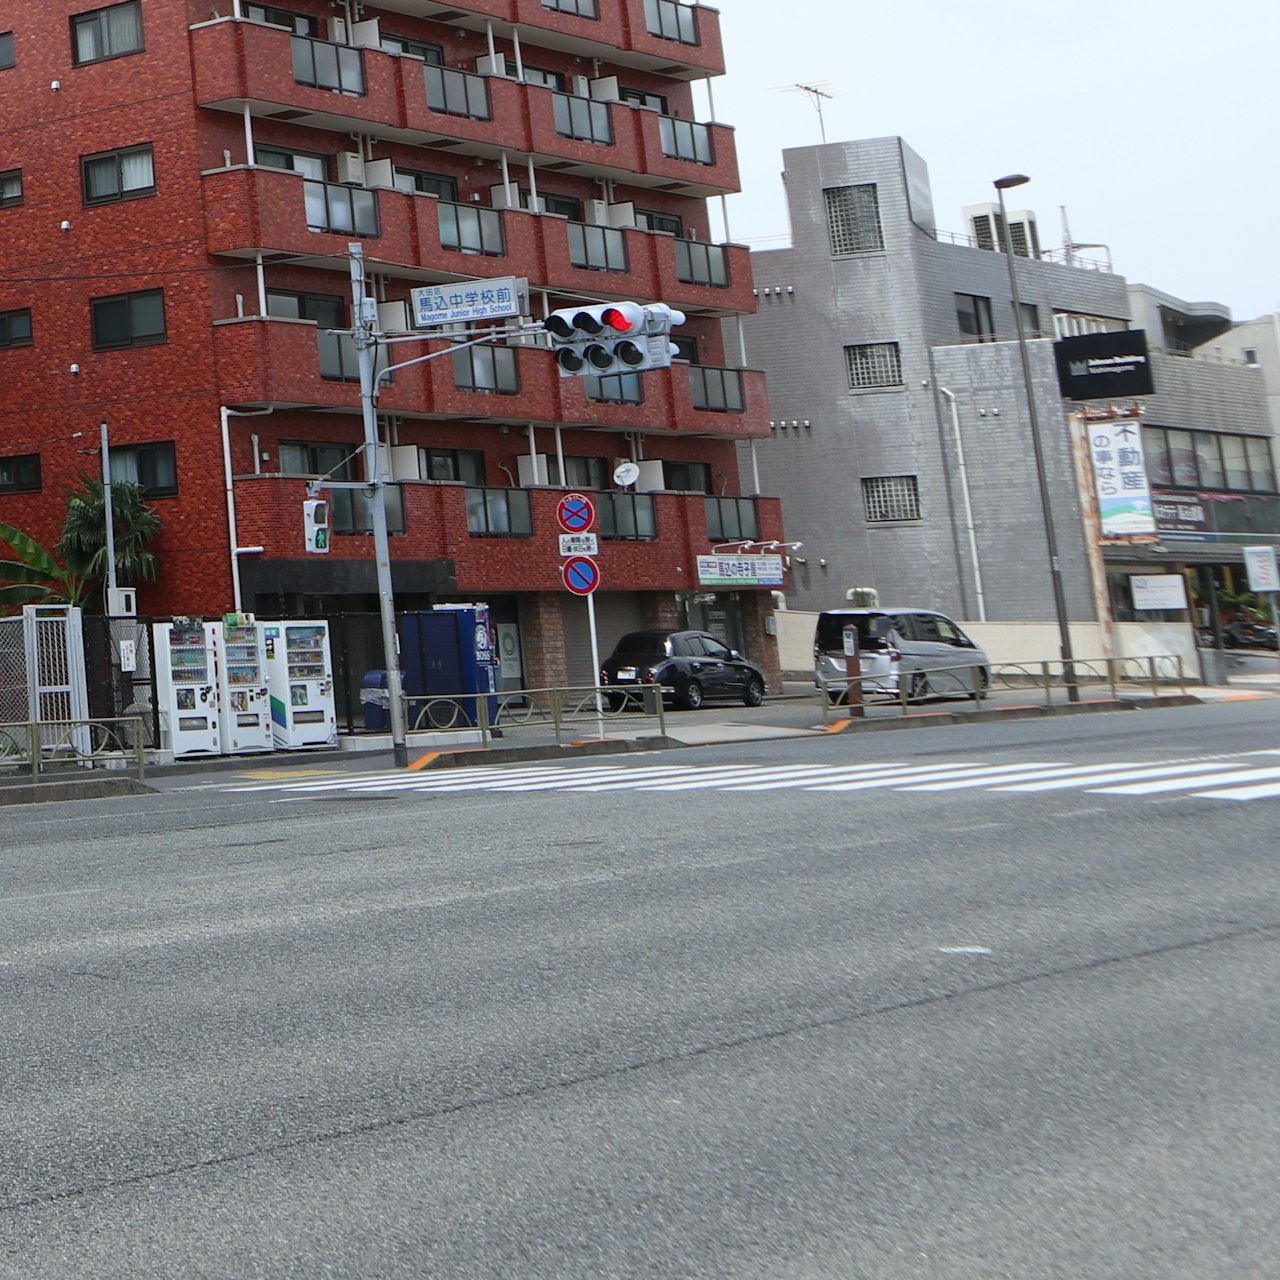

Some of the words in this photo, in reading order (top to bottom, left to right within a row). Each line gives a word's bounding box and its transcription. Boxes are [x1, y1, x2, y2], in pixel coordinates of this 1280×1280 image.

[418, 287, 441, 296] 大田区
[420, 287, 511, 312] 馬込中学校前
[420, 312, 448, 322] Magome
[450, 308, 470, 318] Junior
[472, 305, 488, 317] High
[489, 303, 512, 314] School
[1093, 434, 1118, 496] の事なら
[1114, 422, 1146, 490] 不動産
[475, 650, 491, 661] BOSS
